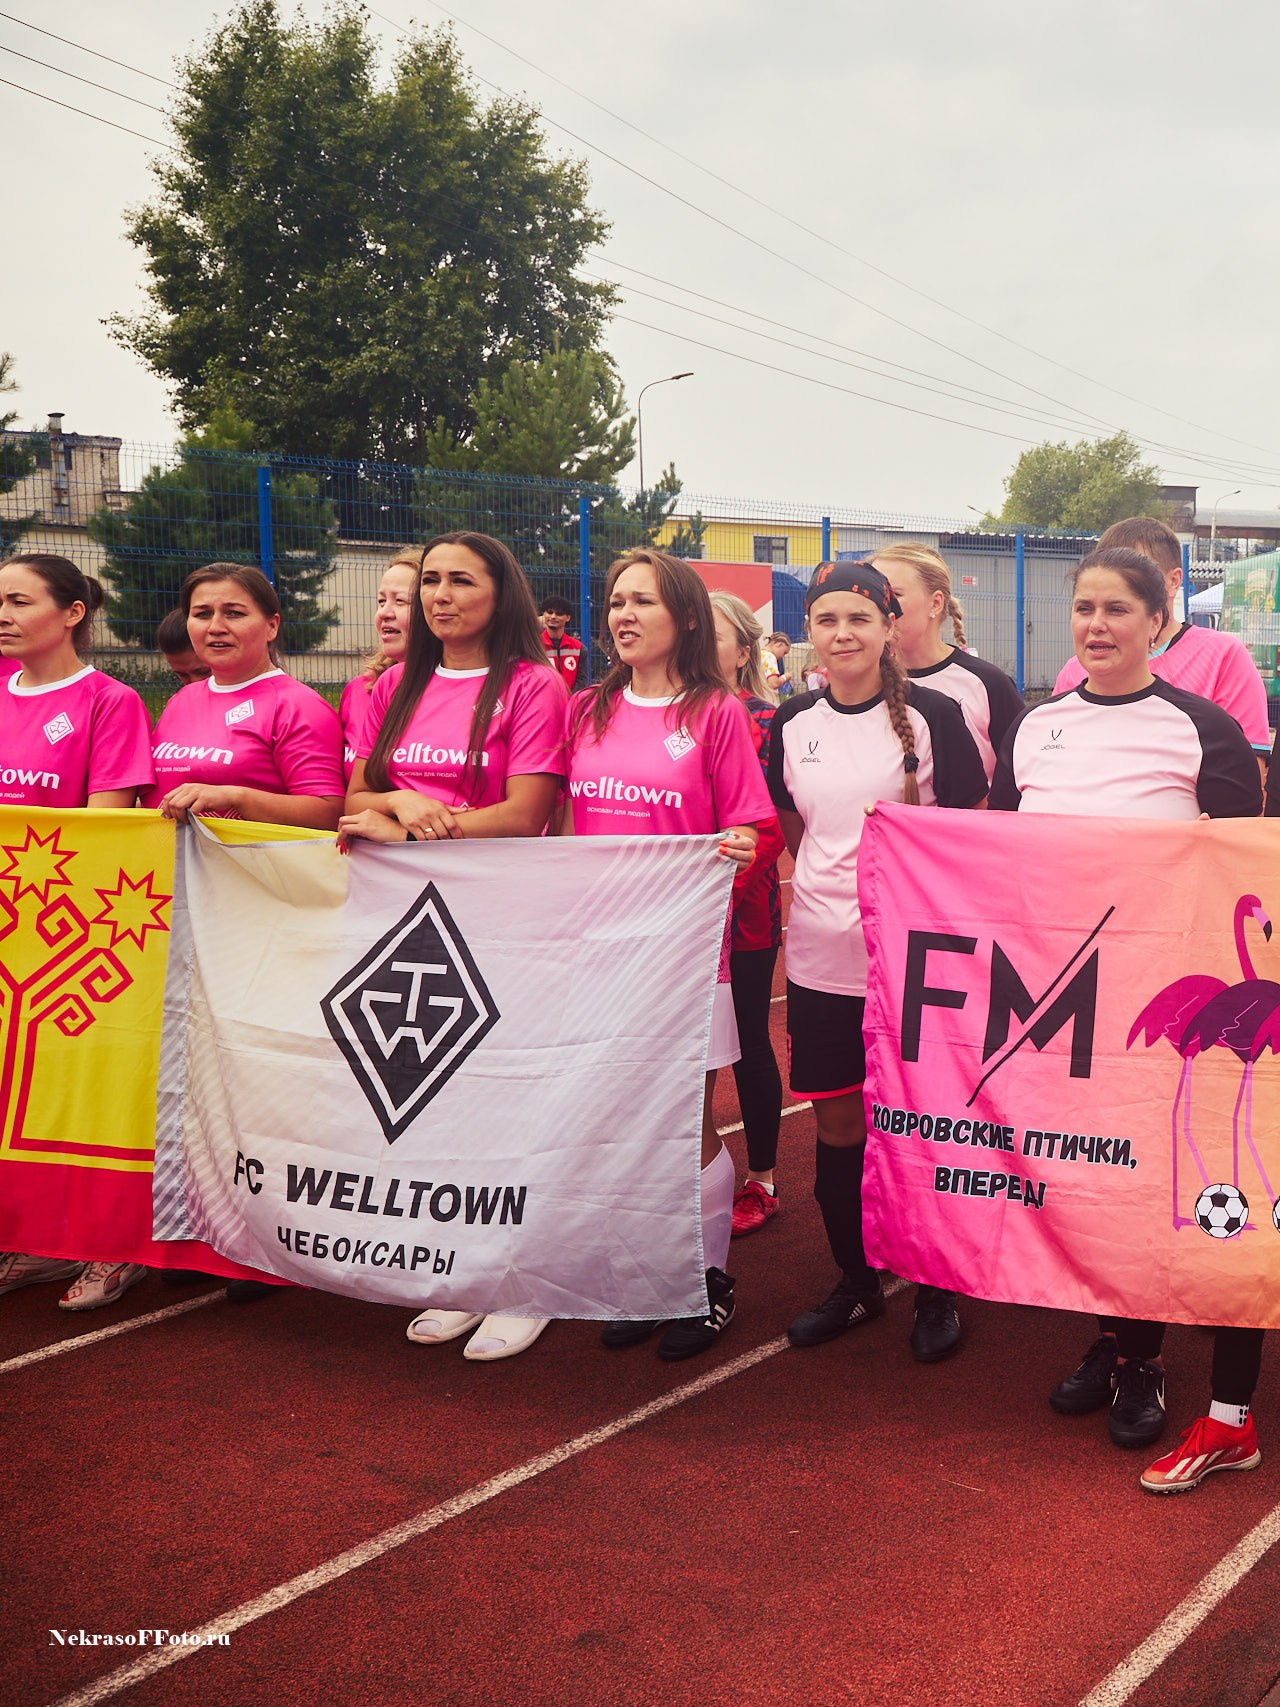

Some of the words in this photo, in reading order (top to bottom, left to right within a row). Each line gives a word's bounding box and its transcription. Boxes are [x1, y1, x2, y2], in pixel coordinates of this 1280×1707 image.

[569, 776, 682, 809] welltown
[587, 806, 613, 815] основан
[614, 808, 626, 816] для
[627, 810, 651, 818] людей
[901, 918, 1106, 1092] FM
[872, 1103, 1015, 1152] КОВРОВСКИЕ
[1022, 1130, 1138, 1169] ПТИЧКИ,
[233, 1150, 265, 1195] FC
[286, 1163, 527, 1225] WELLTOWN
[934, 1166, 1047, 1210] ВПЕРЕД!
[277, 1225, 456, 1275] ЧЕБОКСАРЫ
